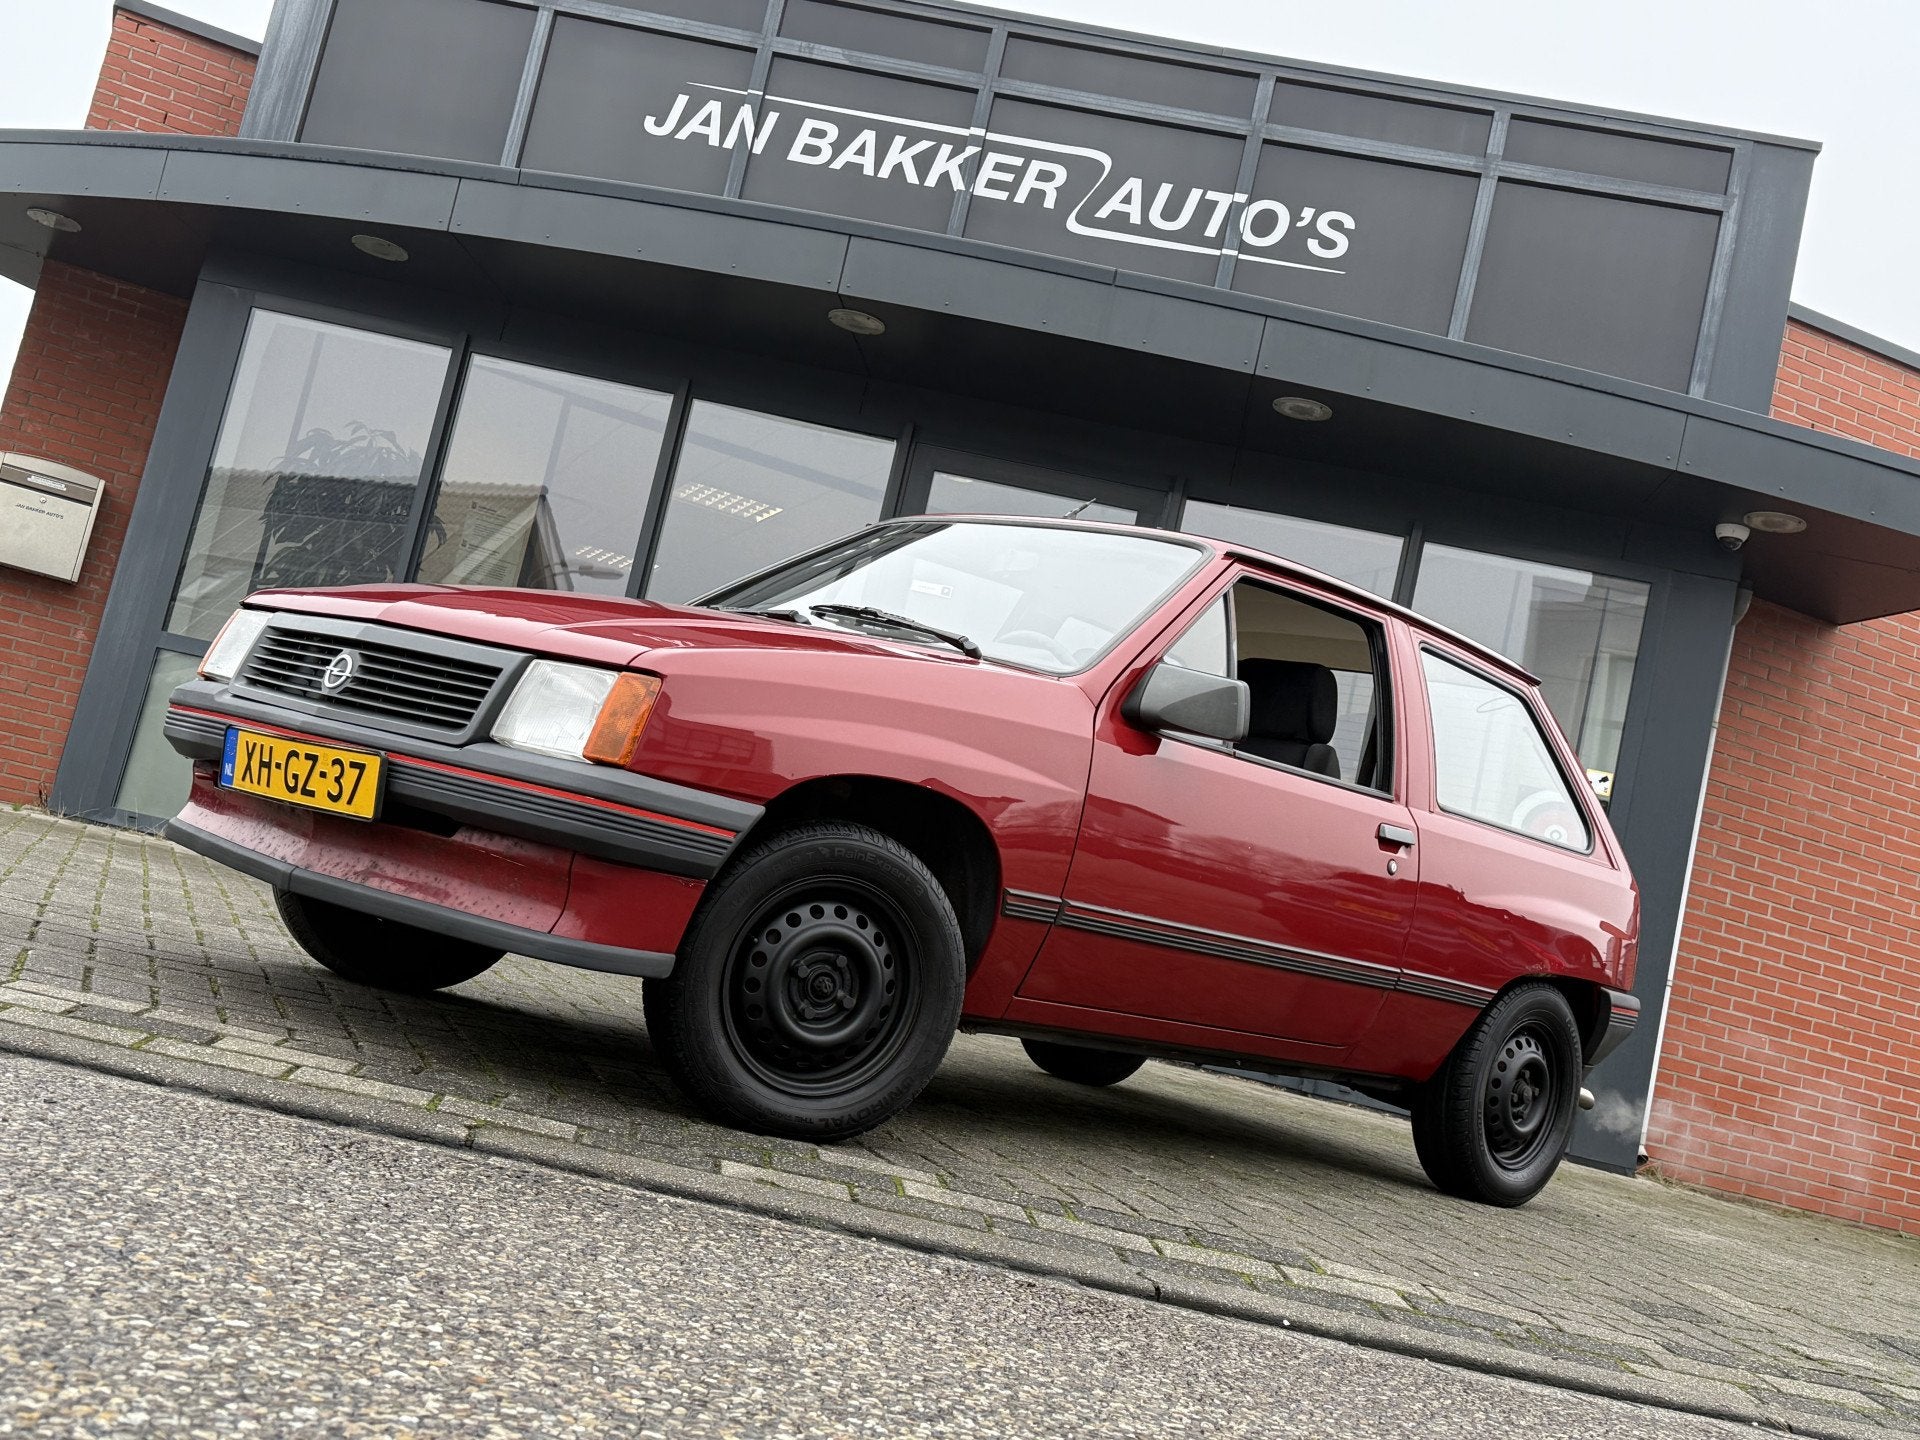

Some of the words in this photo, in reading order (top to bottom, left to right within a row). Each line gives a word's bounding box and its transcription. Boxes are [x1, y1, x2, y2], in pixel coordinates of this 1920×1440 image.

[643, 94, 779, 155] JAN
[787, 118, 1068, 209] BAKKER
[1095, 176, 1357, 260] AUTO'S
[241, 740, 367, 805] XH-GZ-37
